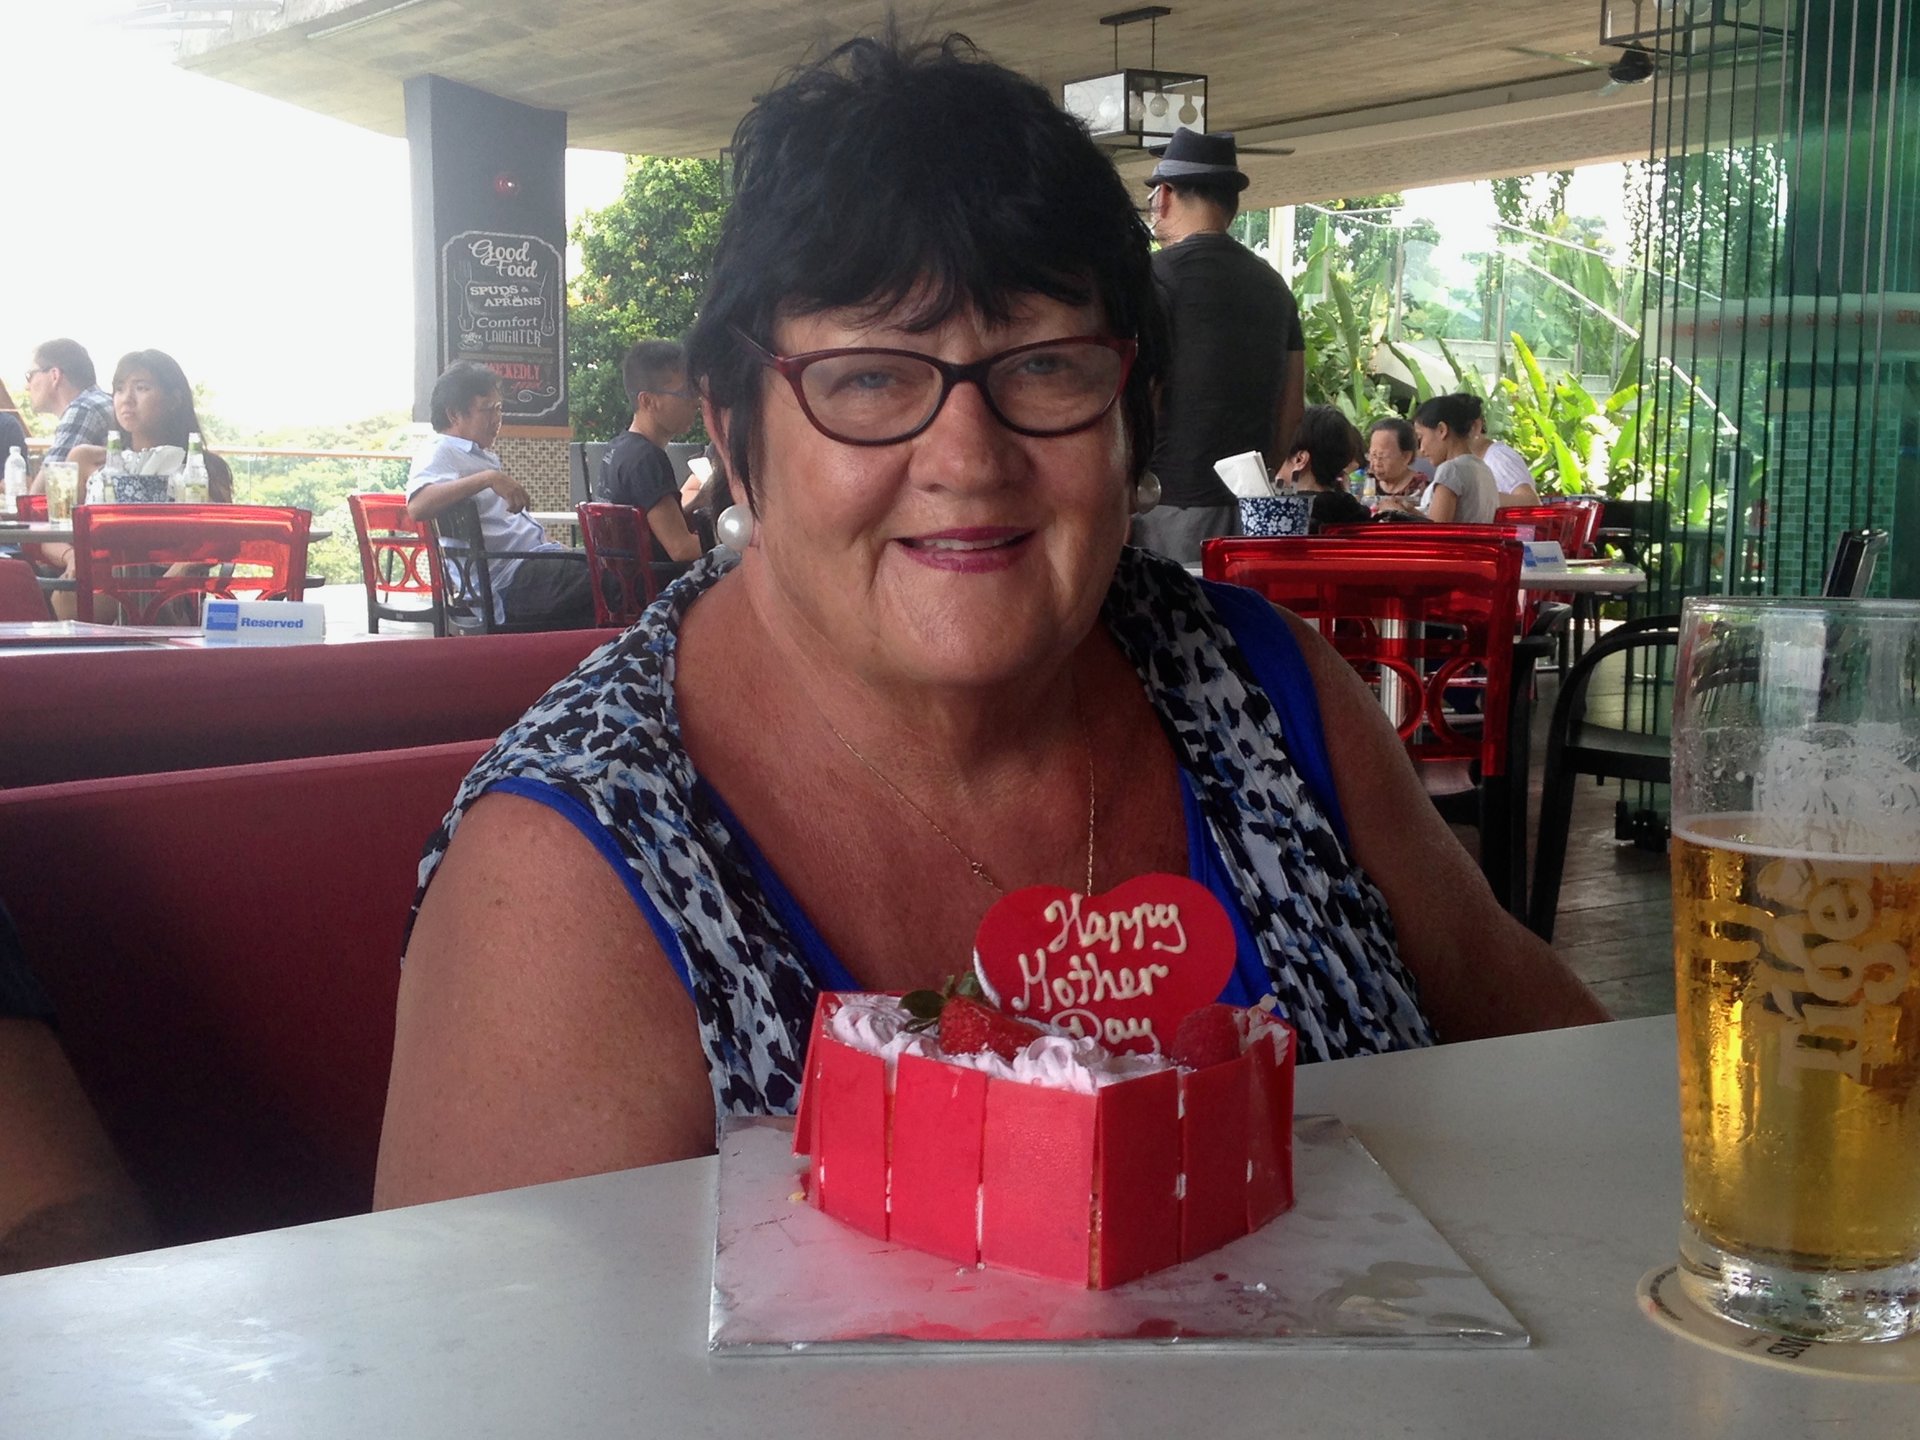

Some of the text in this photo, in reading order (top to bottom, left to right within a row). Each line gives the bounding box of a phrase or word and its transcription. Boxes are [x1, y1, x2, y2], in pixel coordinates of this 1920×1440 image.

[468, 239, 529, 265] Good
[485, 258, 537, 278] Food
[470, 285, 519, 296] SPUDS
[484, 295, 541, 307] APRONS
[476, 316, 537, 328] Comfort
[485, 329, 541, 347] LAUGHTER
[241, 617, 304, 629] Reserved
[1043, 893, 1188, 954] Happy
[1011, 947, 1169, 1012] Mother
[1051, 1008, 1161, 1055] Day
